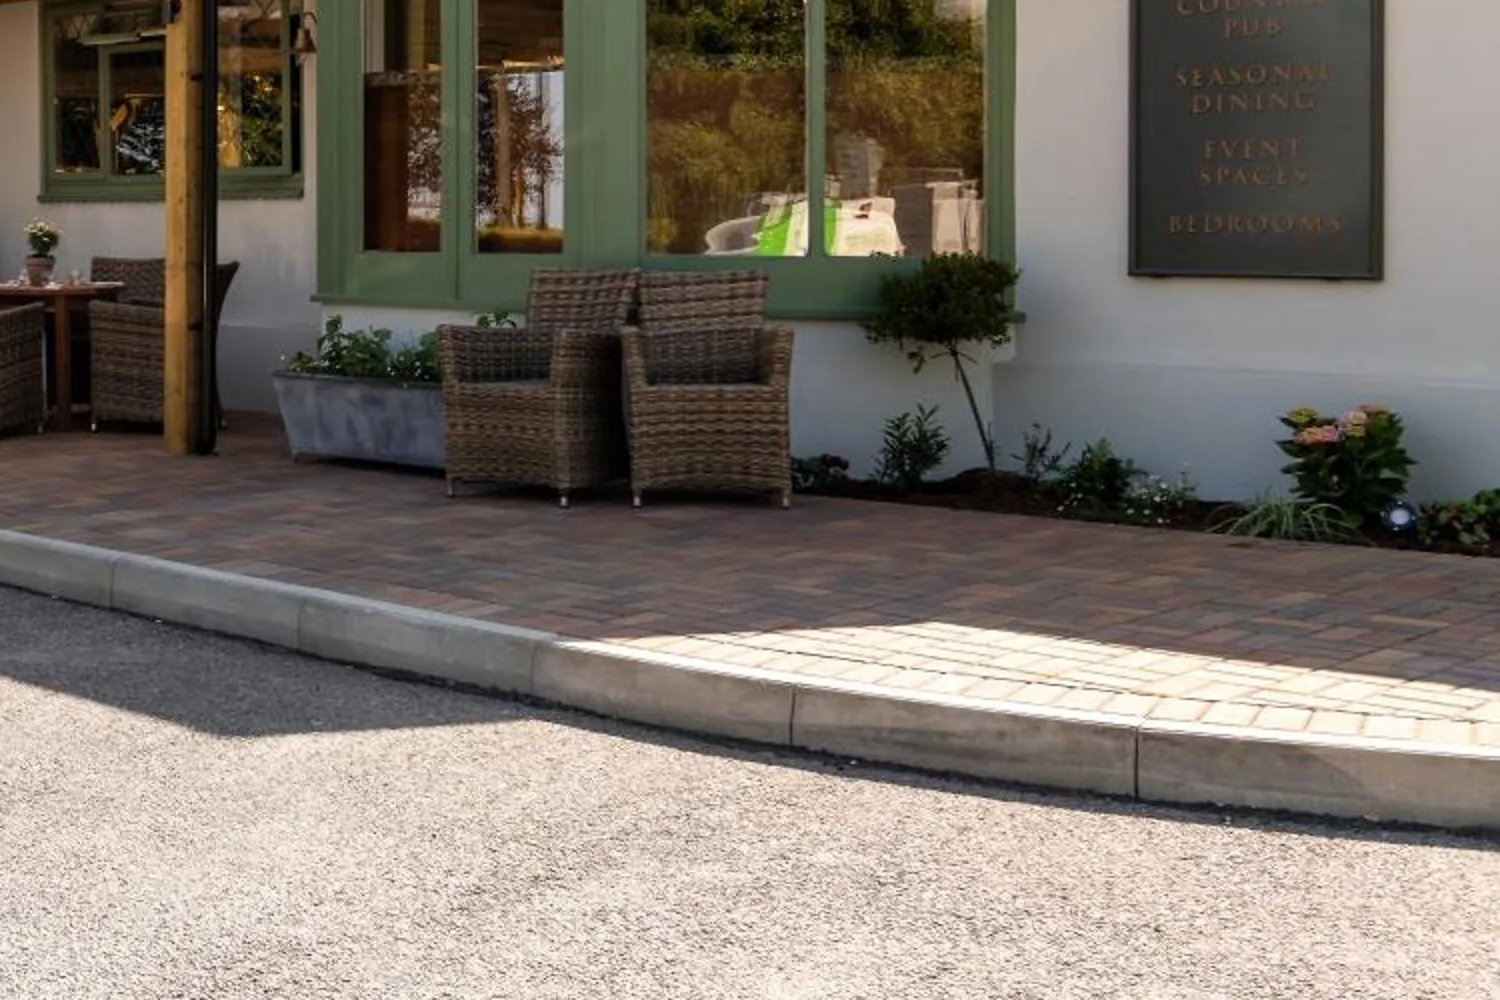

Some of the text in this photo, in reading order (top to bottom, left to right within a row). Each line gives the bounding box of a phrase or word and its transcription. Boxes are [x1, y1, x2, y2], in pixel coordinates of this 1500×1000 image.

[1225, 17, 1282, 37] PUB
[1176, 62, 1334, 87] SEASONAL
[1192, 93, 1315, 114] DINING
[1204, 137, 1303, 159] EVENT
[1199, 166, 1307, 186] SPACES
[1168, 213, 1343, 235] BEDROOMS
